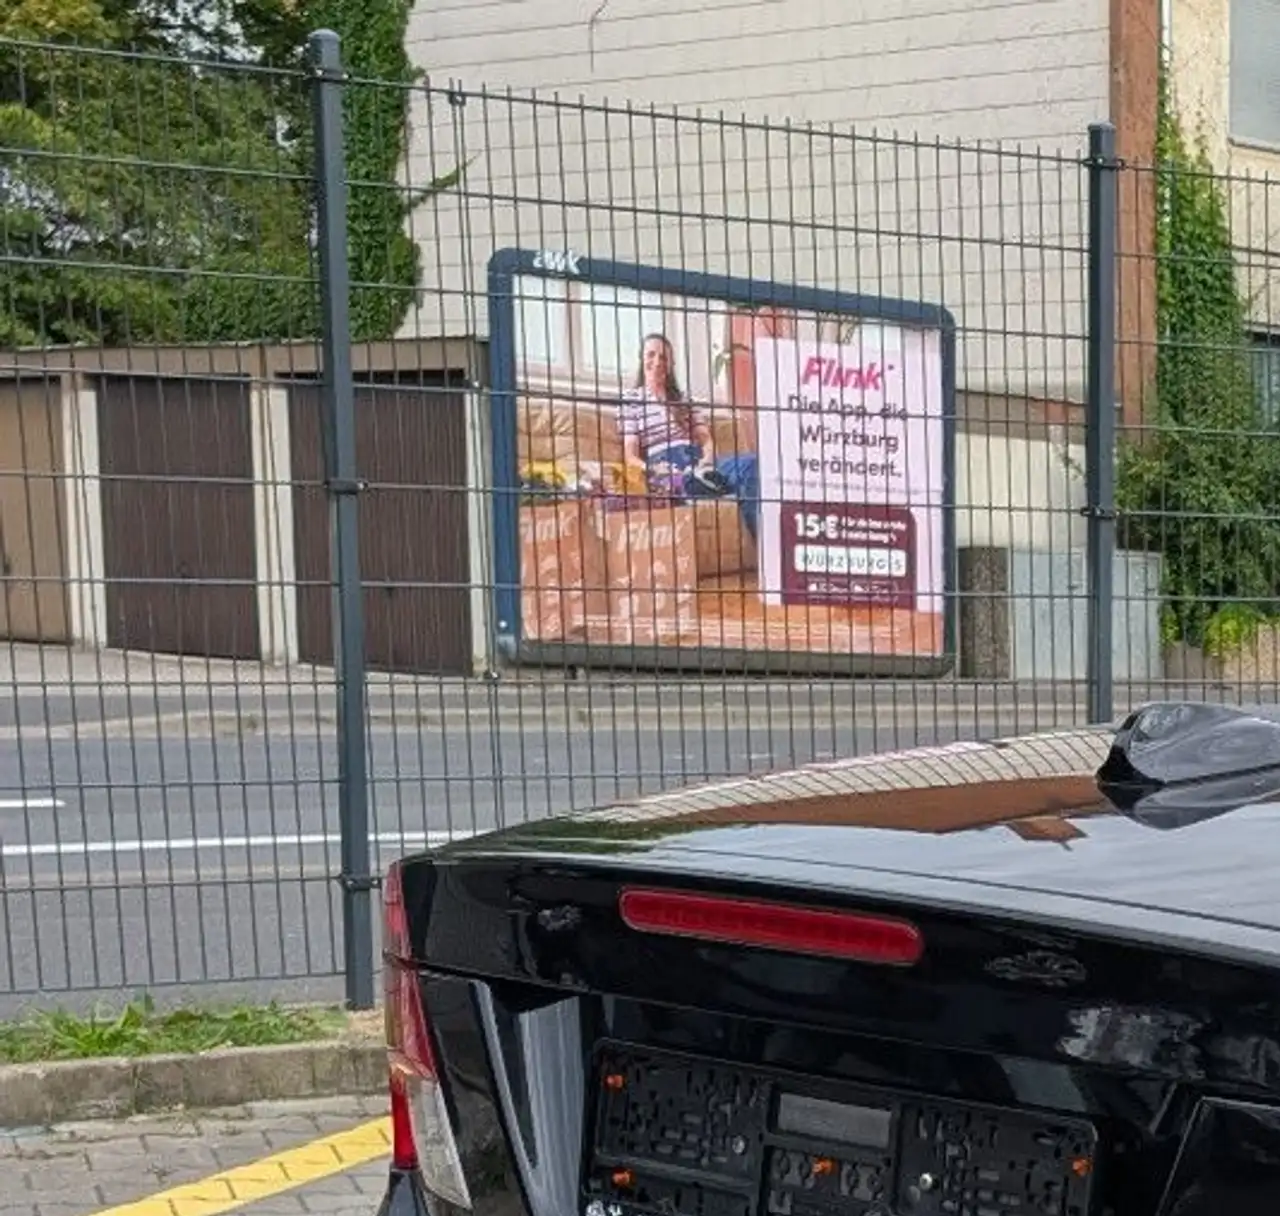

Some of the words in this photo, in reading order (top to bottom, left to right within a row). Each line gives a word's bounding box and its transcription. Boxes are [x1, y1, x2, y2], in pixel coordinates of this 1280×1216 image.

[802, 357, 882, 390] Flink
[789, 395, 821, 413] Die
[801, 424, 898, 453] Würzburg
[798, 457, 902, 477] verändert.
